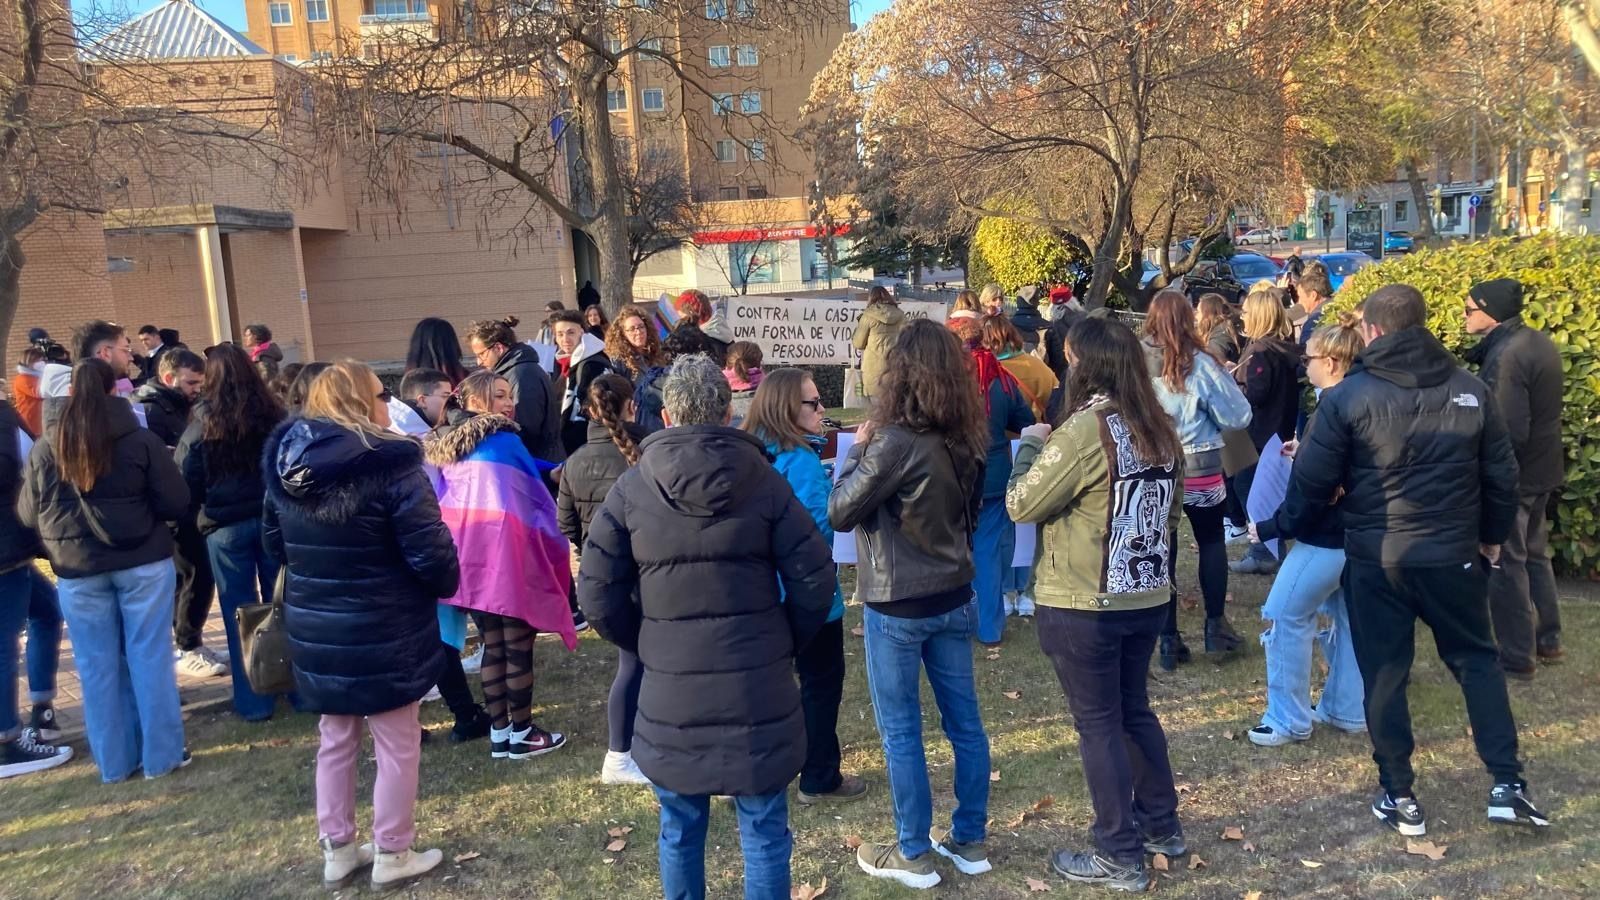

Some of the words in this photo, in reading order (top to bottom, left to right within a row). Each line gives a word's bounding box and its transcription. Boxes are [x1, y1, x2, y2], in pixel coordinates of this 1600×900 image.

[736, 306, 790, 322] CONTRA
[803, 307, 816, 322] LA
[825, 307, 865, 323] CAST
[734, 325, 756, 339] UNA
[761, 325, 805, 340] FORMA
[810, 326, 824, 340] DE
[771, 343, 835, 359] PERSONAS
